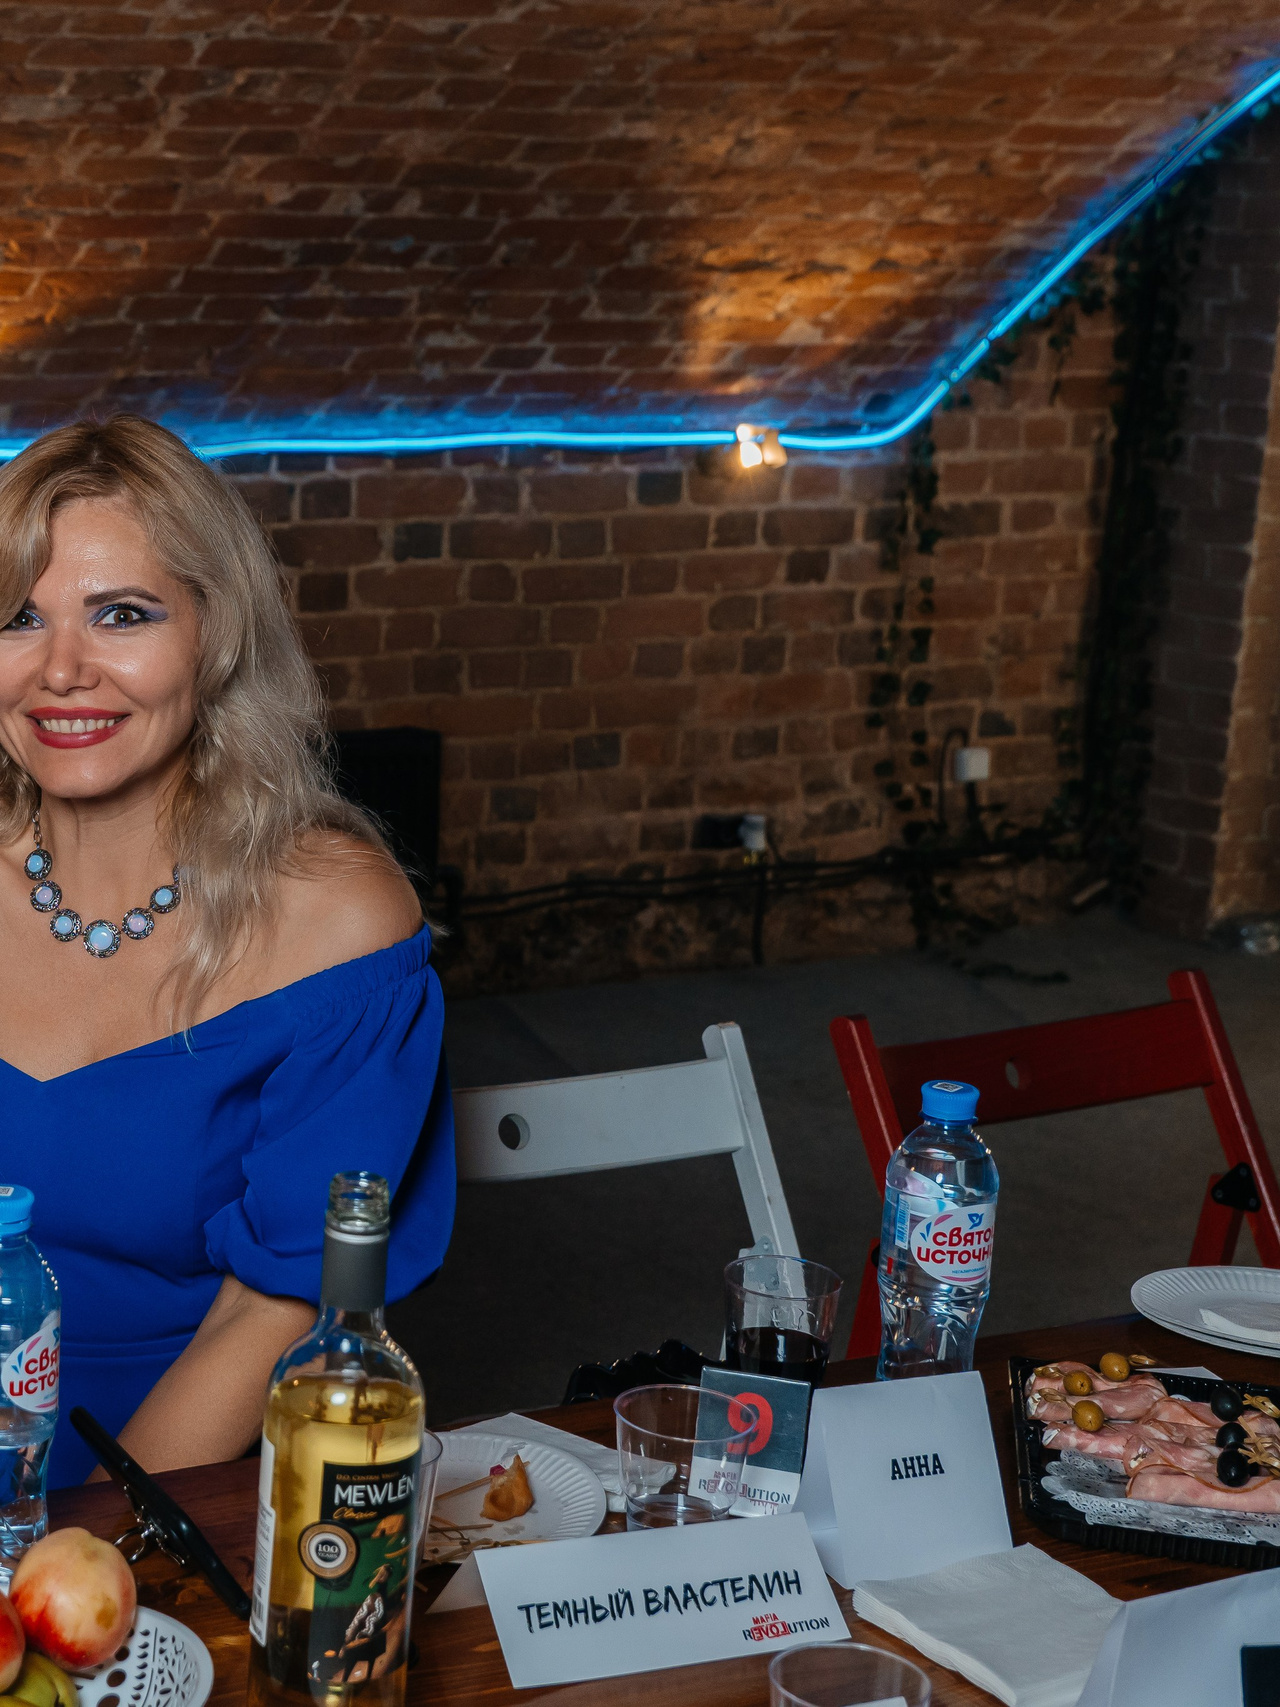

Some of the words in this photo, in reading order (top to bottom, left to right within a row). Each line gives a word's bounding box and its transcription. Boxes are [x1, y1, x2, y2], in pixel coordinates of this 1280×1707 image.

[917, 1244, 993, 1265] ИСТОЧН
[10, 1367, 59, 1396] ИСТО
[727, 1391, 773, 1456] 9
[890, 1452, 945, 1481] АННА
[334, 1474, 415, 1506] MEWLÉN
[317, 1543, 339, 1554] 100
[517, 1588, 635, 1634] ТЕМНЫЙ
[643, 1568, 803, 1617] ВЛАСТЕЛИН
[751, 1612, 780, 1626] MAFIA
